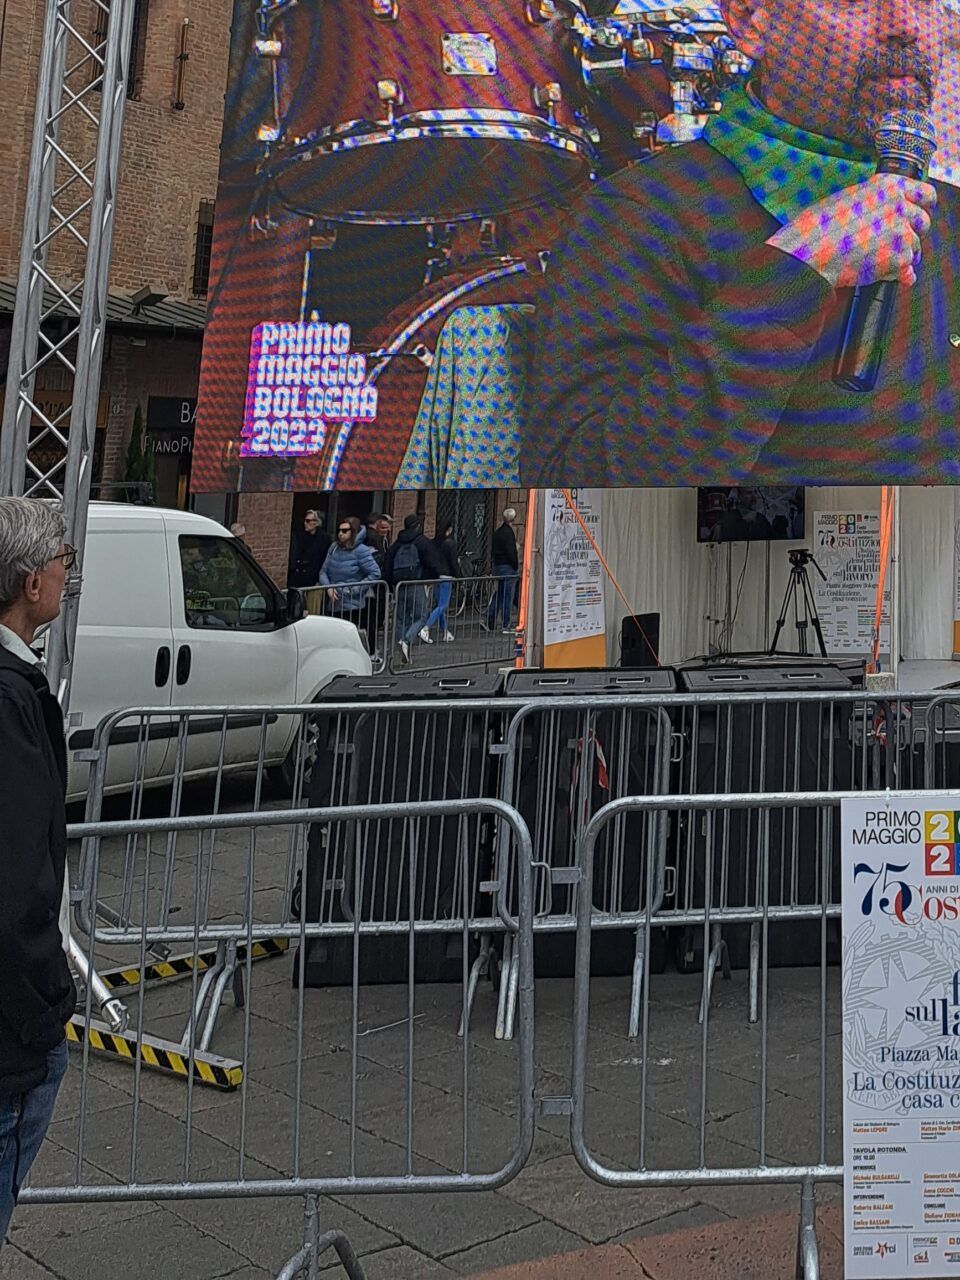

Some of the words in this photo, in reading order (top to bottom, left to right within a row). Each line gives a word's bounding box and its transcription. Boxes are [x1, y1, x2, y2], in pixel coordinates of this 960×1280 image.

[261, 322, 351, 354] PRIMO
[256, 354, 366, 387] MAGGIO
[253, 386, 378, 418] BOLOGNA
[251, 418, 327, 452] 2023
[865, 810, 921, 827] PRIMO
[852, 828, 922, 844] MAGGIO
[854, 862, 912, 916] 75
[926, 885, 948, 894] ANNI
[905, 998, 938, 1022] sul
[880, 1046, 930, 1062] Piazza
[852, 1072, 876, 1091] La
[902, 1093, 944, 1109] casa
